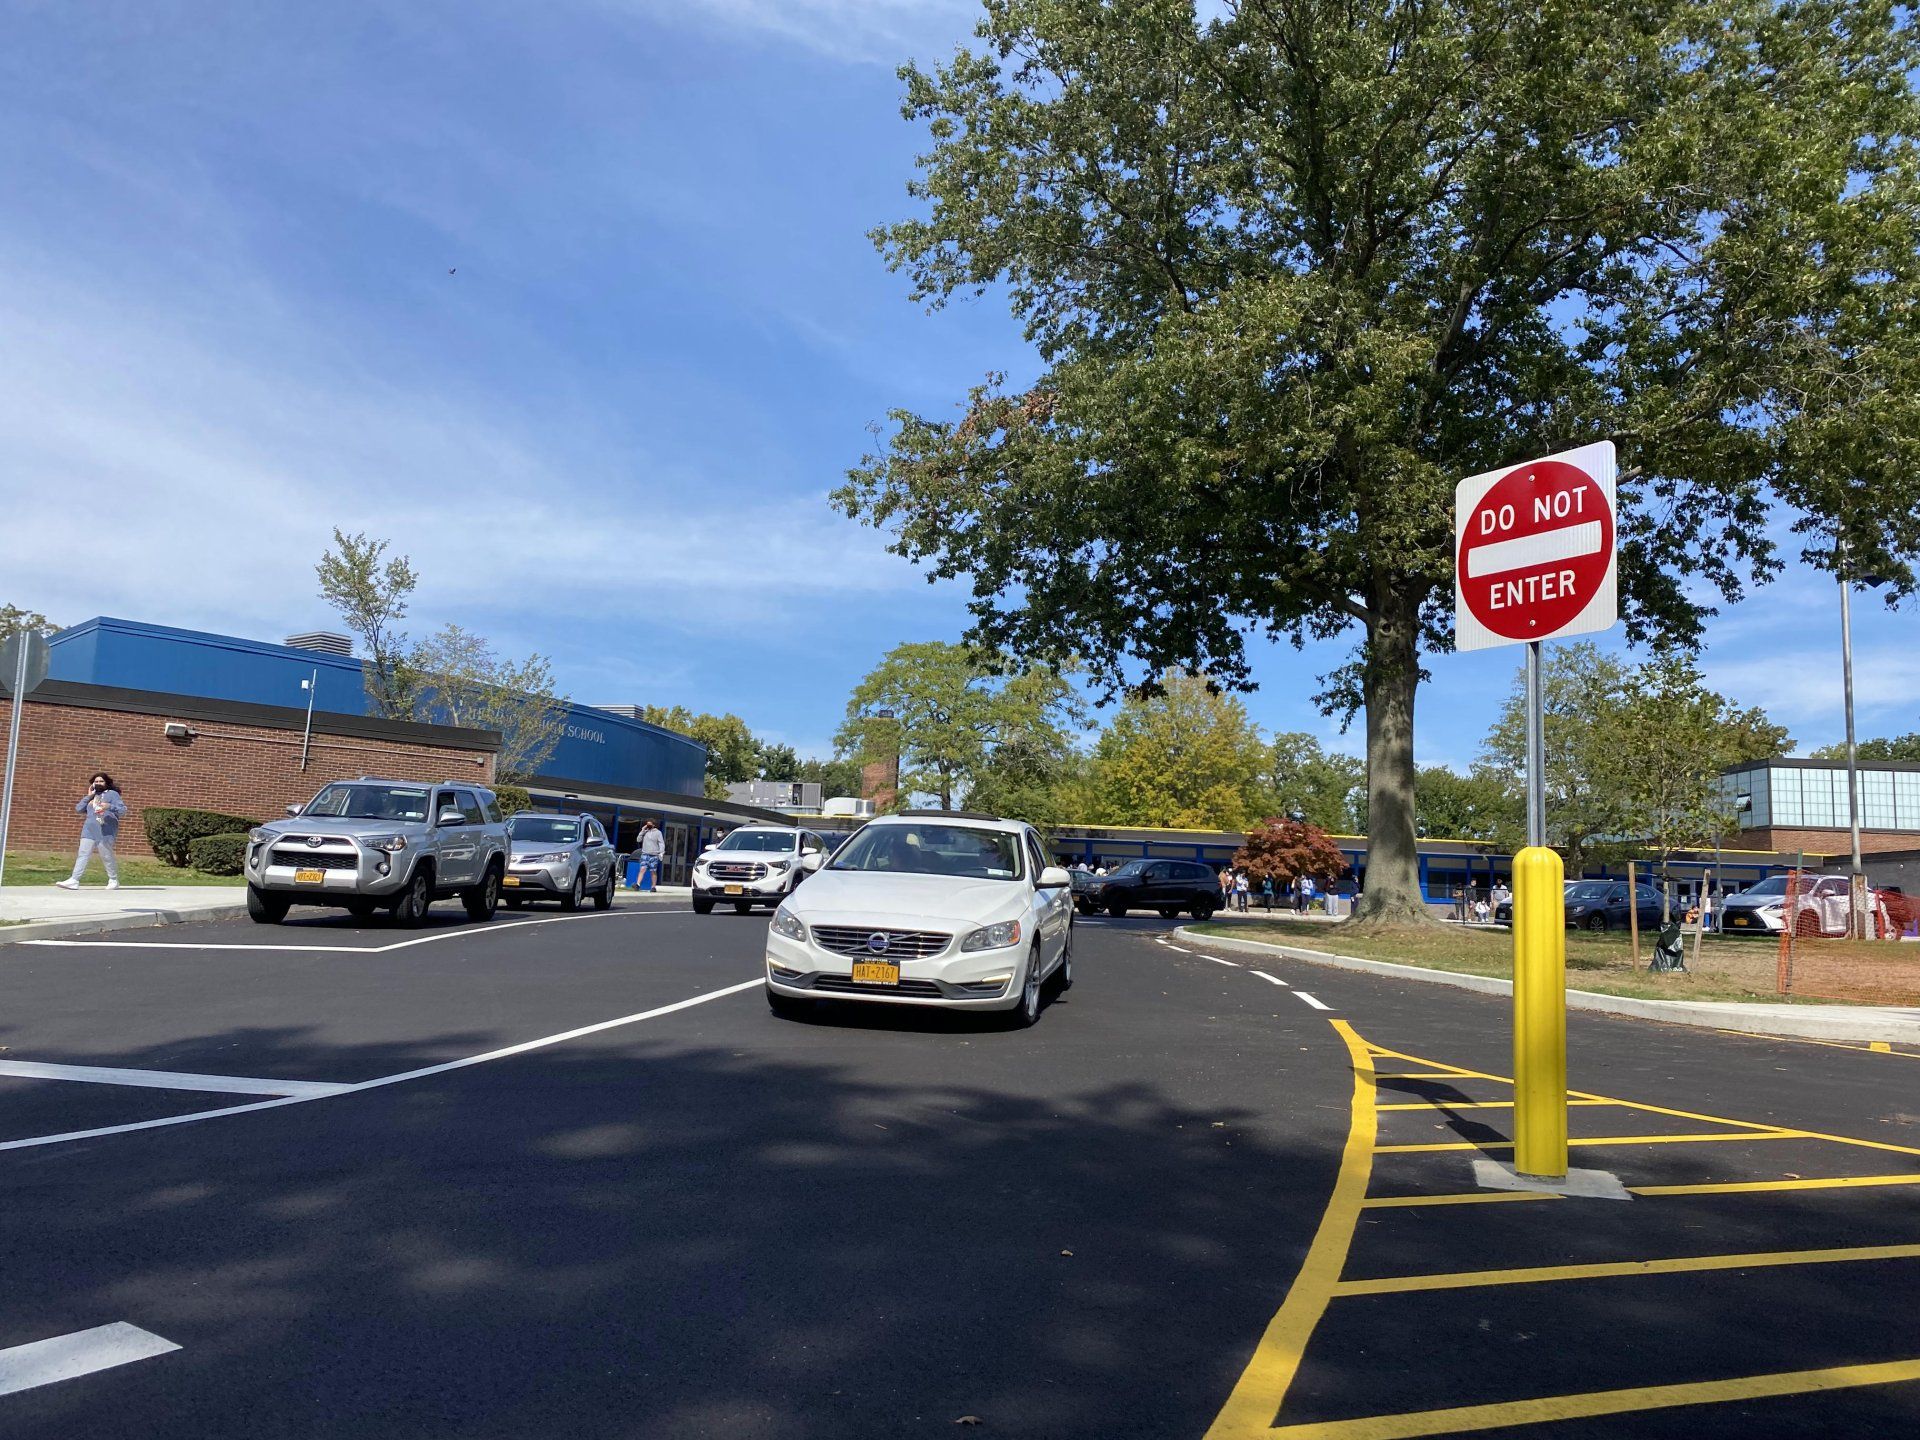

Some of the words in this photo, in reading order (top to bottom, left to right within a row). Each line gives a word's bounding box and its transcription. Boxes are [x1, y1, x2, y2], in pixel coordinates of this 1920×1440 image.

[1481, 504, 1515, 535] DO
[1534, 485, 1588, 523] NOT
[1490, 569, 1576, 610] ENTER
[567, 725, 606, 744] SCHOOL
